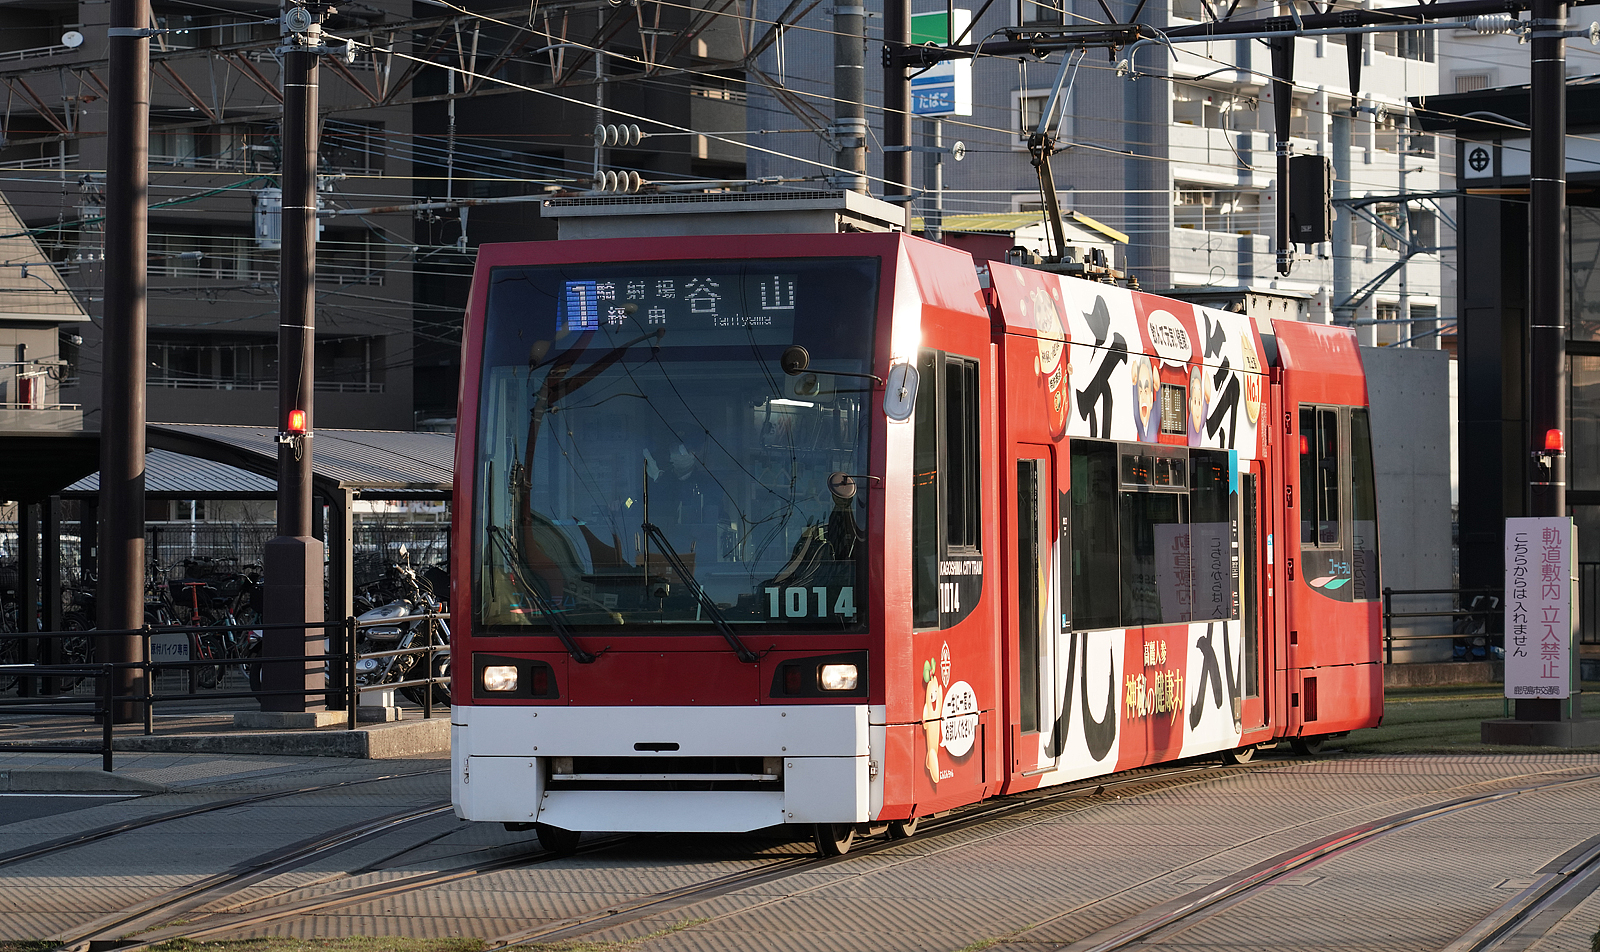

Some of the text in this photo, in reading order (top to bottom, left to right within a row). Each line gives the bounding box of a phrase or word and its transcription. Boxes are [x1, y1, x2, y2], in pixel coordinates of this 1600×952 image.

[919, 92, 949, 108] たばこ
[572, 284, 588, 327] 1
[684, 276, 795, 314] 谷山
[711, 313, 771, 326] Taniyama
[1247, 375, 1260, 403] No.1
[940, 560, 962, 576] KAGOSHIMA
[963, 560, 971, 575] CITY
[1328, 559, 1351, 575] ユートラム
[764, 586, 857, 618] 1014
[940, 582, 960, 613] 1014
[1513, 532, 1528, 658] こちらからは入れません
[1143, 640, 1167, 667] 高麗人参
[1125, 669, 1184, 727] 神秘の健康力
[1514, 685, 1560, 695] 鹿児島市交通局
